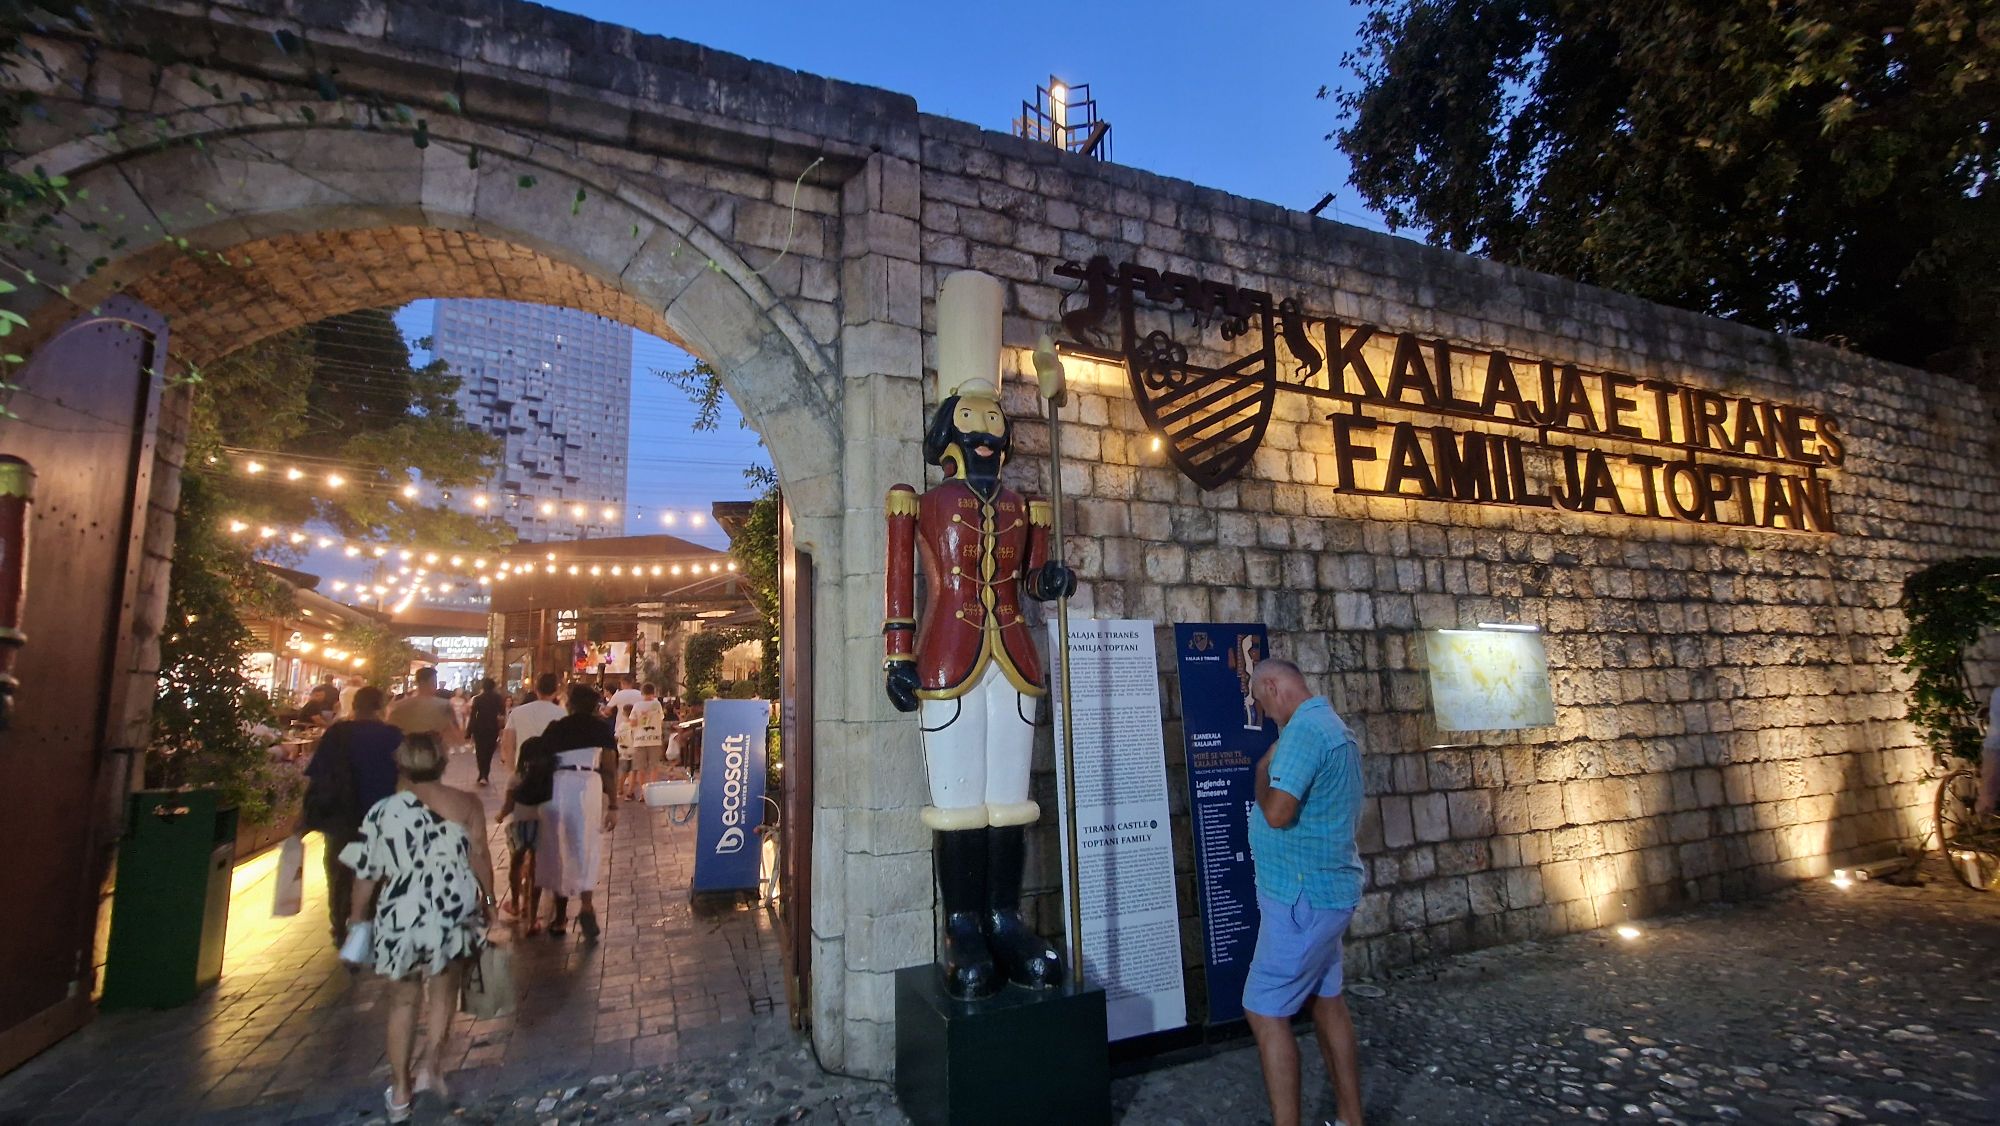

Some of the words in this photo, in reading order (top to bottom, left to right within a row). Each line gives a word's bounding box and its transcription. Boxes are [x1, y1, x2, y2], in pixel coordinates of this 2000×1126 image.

[1324, 317, 1600, 432] KALAJA
[1601, 371, 1643, 438] E
[1643, 380, 1845, 468] TIRANES
[1328, 412, 1626, 515] FAMILJA
[1104, 630, 1139, 639] TIRANËS
[1104, 644, 1138, 652] TOPTANI
[743, 734, 751, 784] PROFESSIONALS
[721, 733, 743, 827] ecosoft
[1196, 778, 1225, 790] Legjenda
[1083, 824, 1115, 834] TIRANA
[1117, 820, 1149, 831] CASTLE
[1082, 837, 1119, 848] TOPTANI
[1121, 834, 1152, 845] FAMILY
